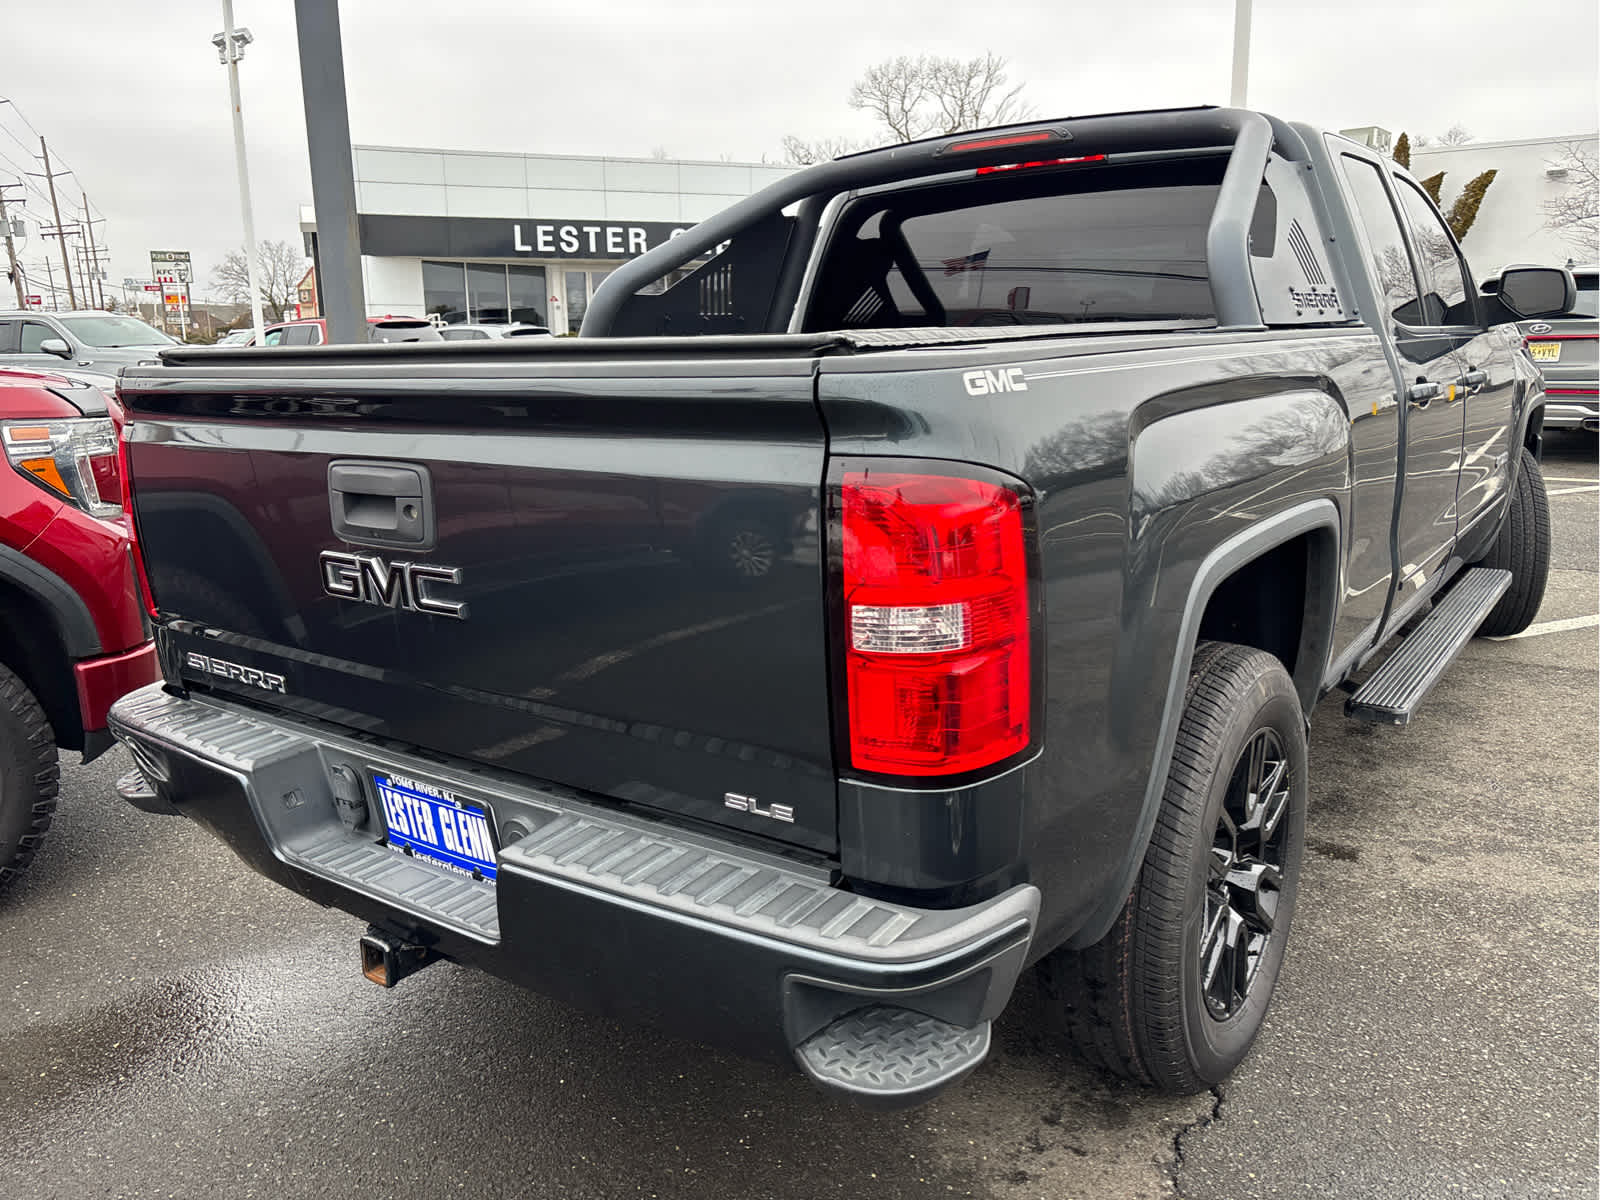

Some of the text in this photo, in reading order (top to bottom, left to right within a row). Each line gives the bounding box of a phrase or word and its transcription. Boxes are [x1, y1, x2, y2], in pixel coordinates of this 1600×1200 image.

[513, 224, 648, 253] LESTER
[1291, 292, 1341, 309] SIERRA
[962, 367, 1029, 396] GMC
[318, 549, 471, 621] GMC
[186, 651, 287, 695] SIERRA
[724, 792, 795, 824] SLE
[378, 786, 498, 865] LESTER GLENN
